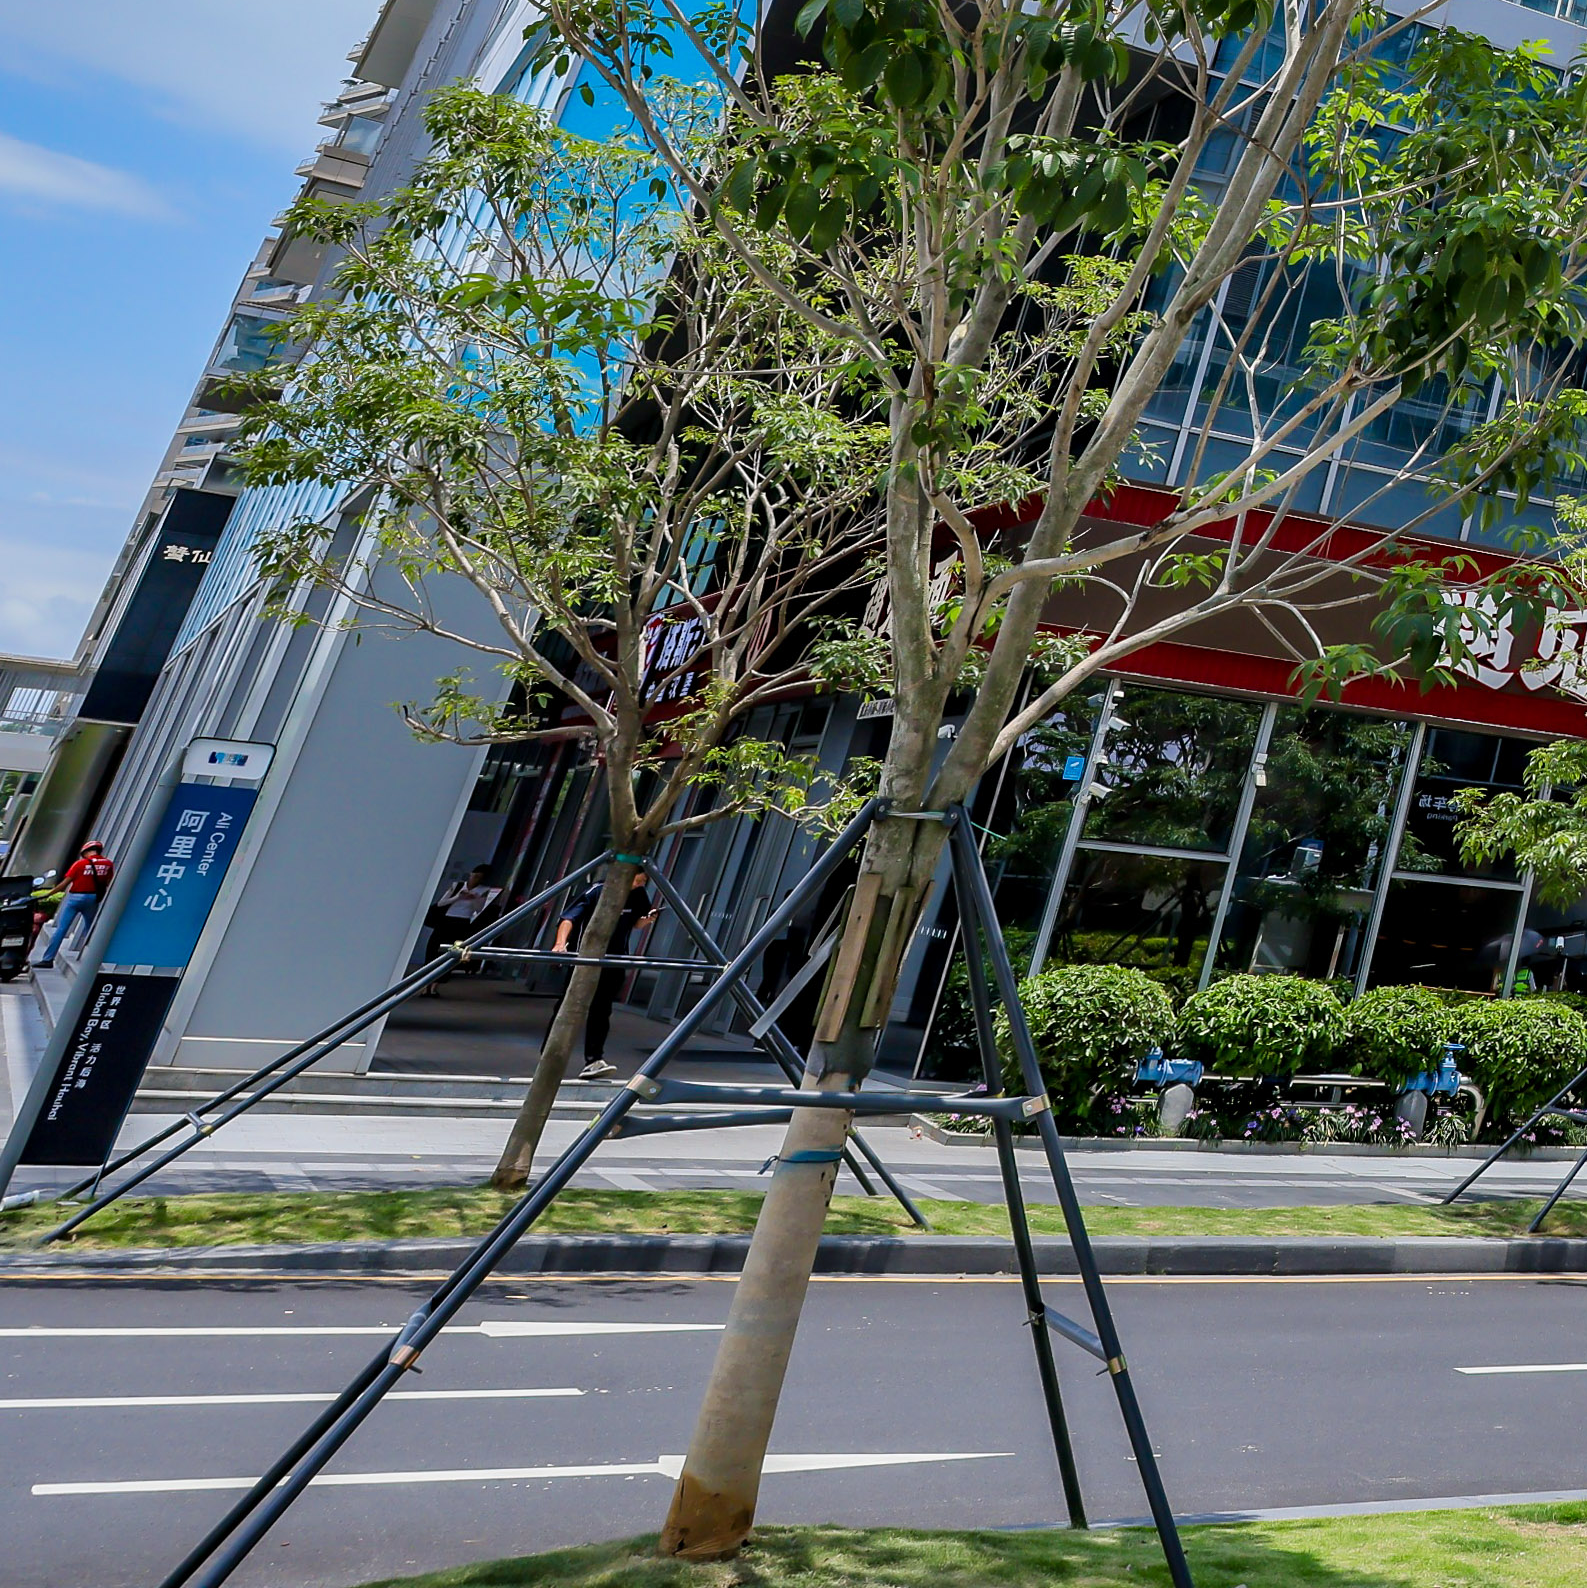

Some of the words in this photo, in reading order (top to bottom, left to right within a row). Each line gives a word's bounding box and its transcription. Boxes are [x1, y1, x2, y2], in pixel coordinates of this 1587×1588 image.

[215, 812, 233, 829] Ali
[144, 809, 210, 911] 阿里中心
[196, 832, 226, 876] Center
[91, 983, 113, 1017] Global
[79, 1019, 99, 1041] Bay,
[63, 1043, 89, 1081] Vibrant
[47, 1083, 72, 1120] Houhai
